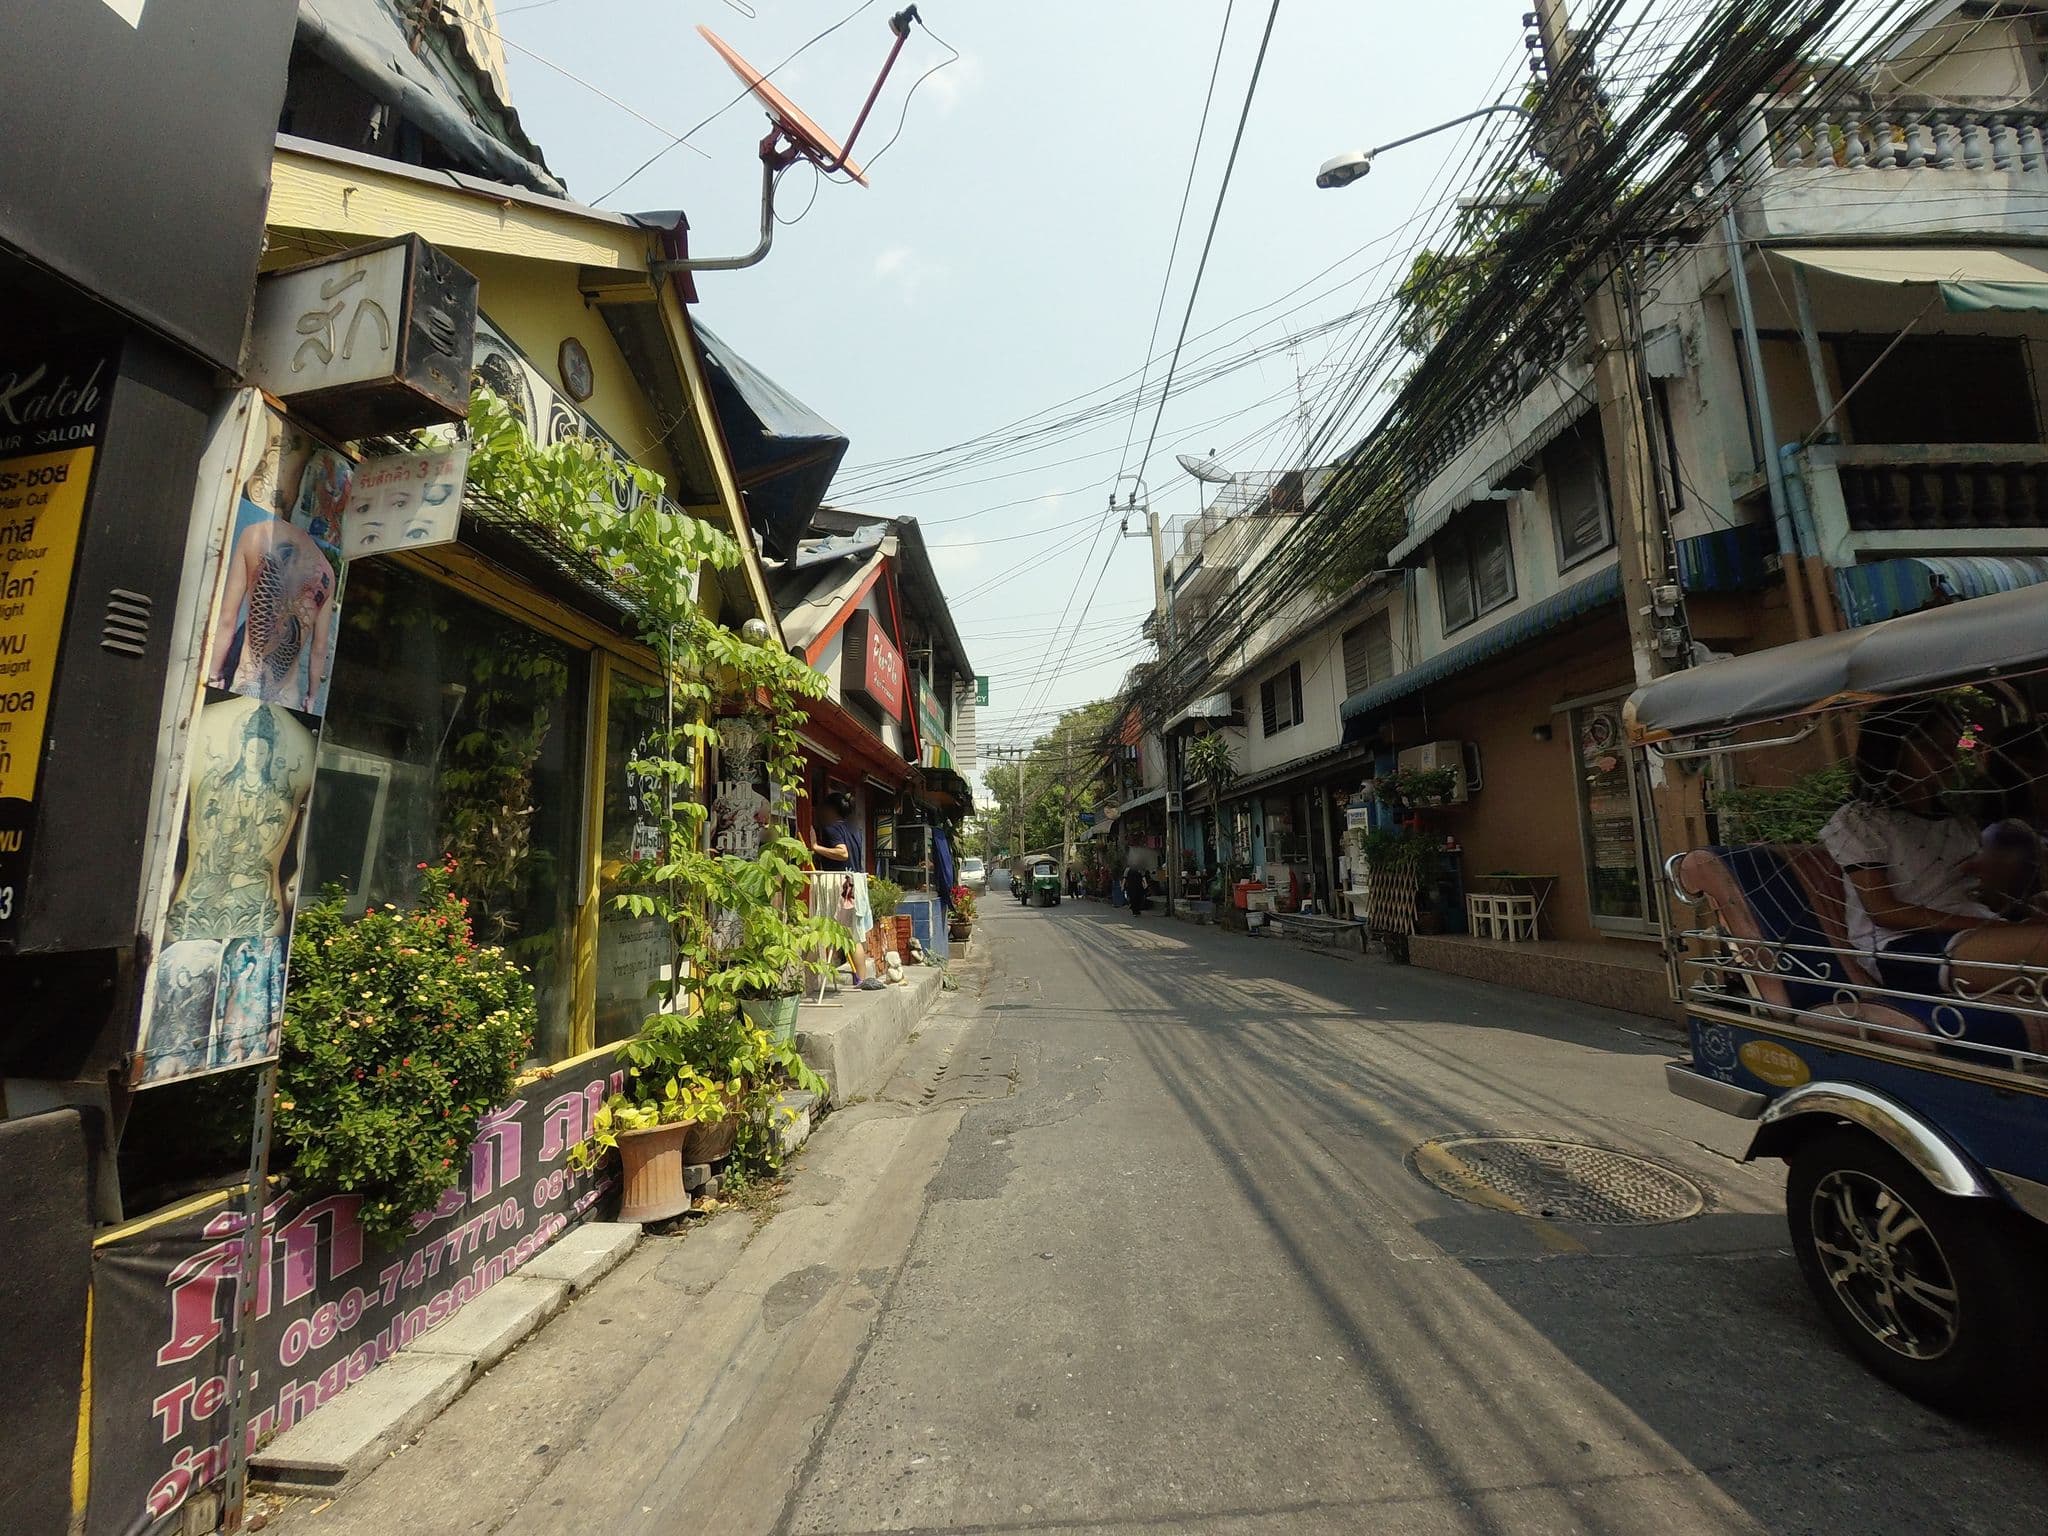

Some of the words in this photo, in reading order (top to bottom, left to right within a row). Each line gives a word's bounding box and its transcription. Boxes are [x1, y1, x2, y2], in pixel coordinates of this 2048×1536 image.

[291, 269, 391, 373] สัก
[35, 423, 97, 446] SALON
[418, 460, 429, 479] 3
[26, 492, 49, 506] Cut
[7, 547, 49, 562] Colour
[157, 1191, 364, 1367] สัก
[279, 1196, 525, 1367] 089-7477770,
